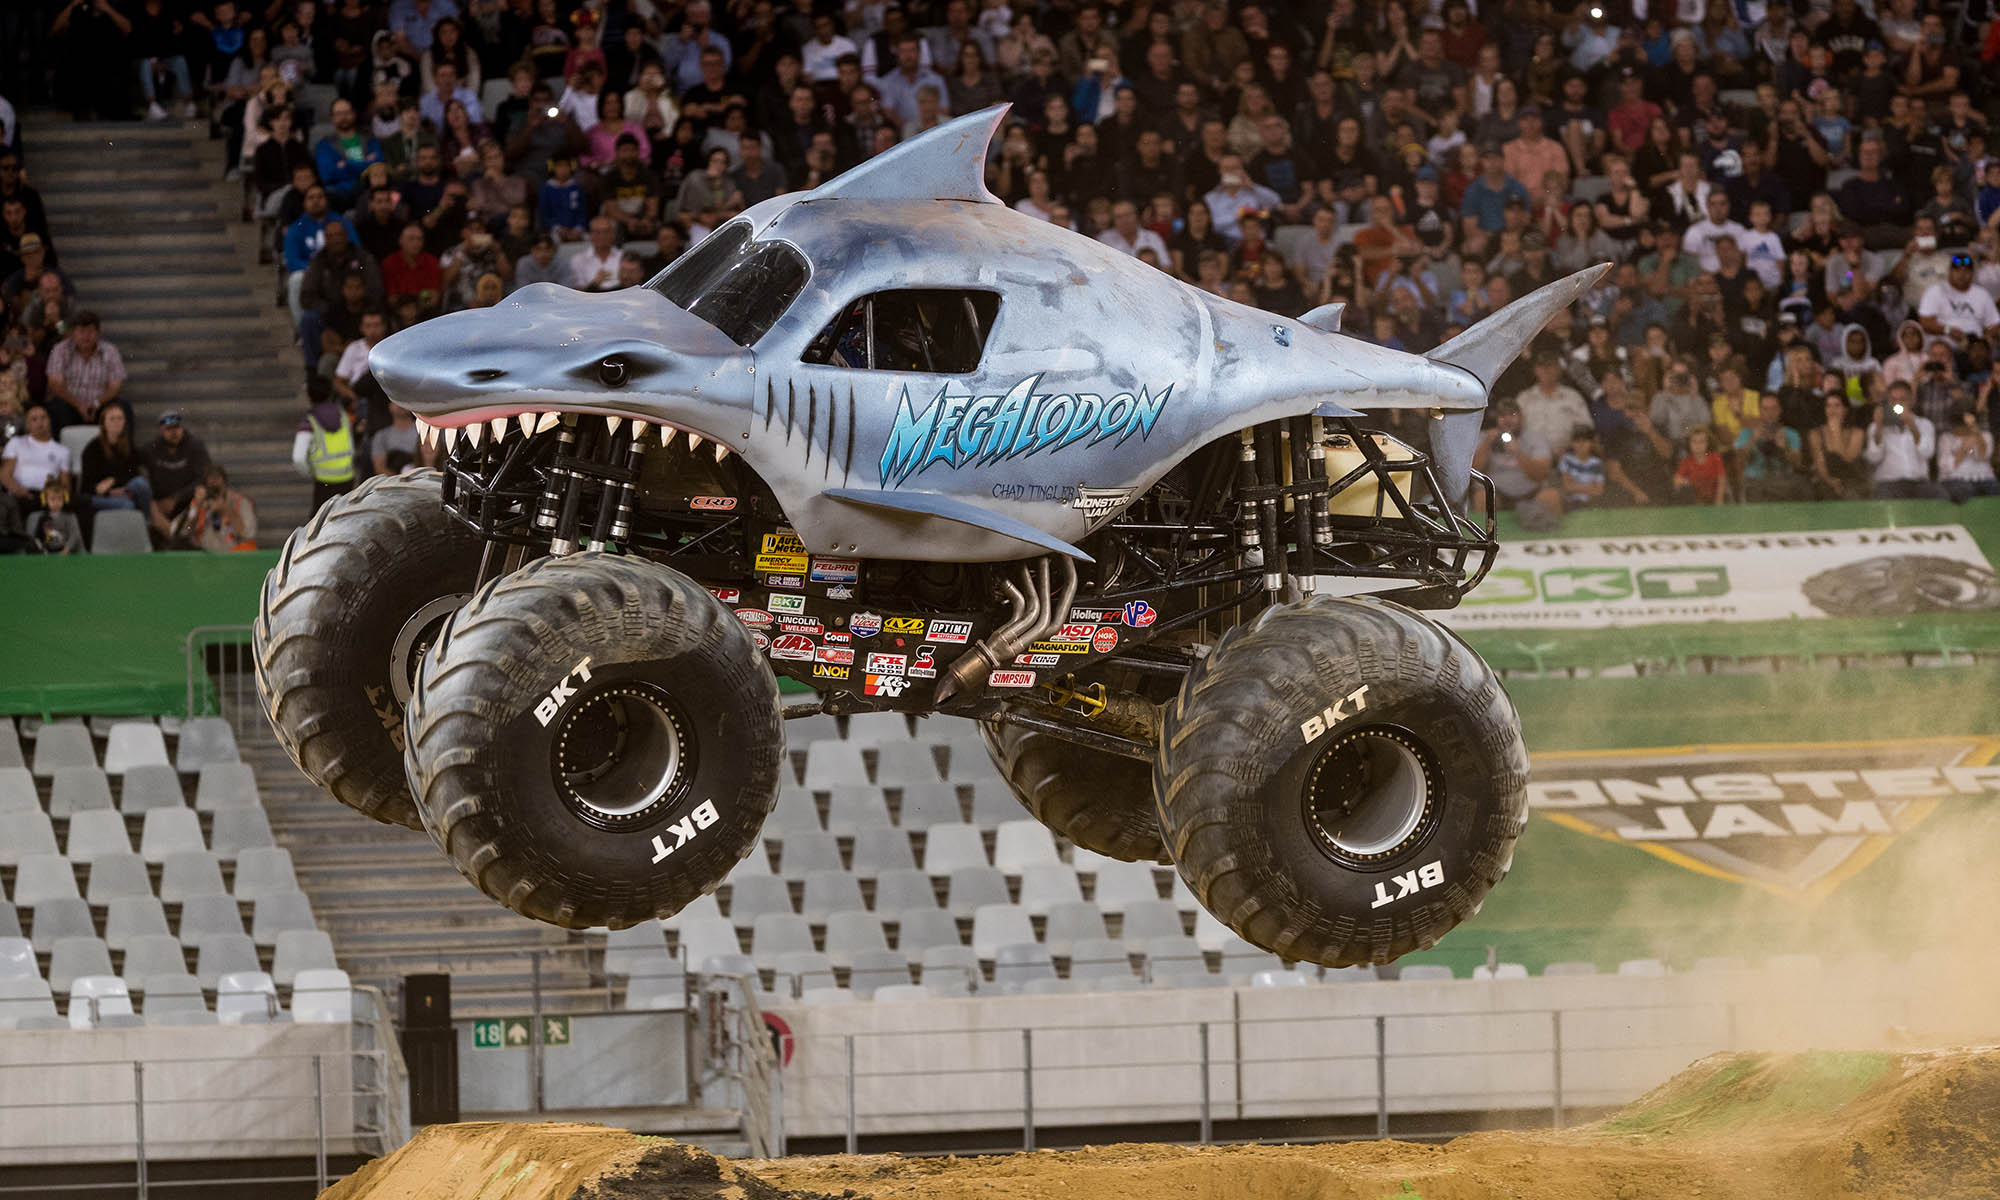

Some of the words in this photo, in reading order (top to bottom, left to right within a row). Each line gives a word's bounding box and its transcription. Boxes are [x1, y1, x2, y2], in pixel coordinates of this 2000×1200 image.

[878, 371, 1175, 490] MEGALODON
[992, 483, 1025, 501] CHAD
[1028, 484, 1075, 501] TINGLER
[694, 498, 735, 506] CRD
[1072, 496, 1131, 509] MONSTER
[1086, 507, 1112, 518] JAM
[1600, 536, 1834, 555] MONSTER
[1857, 531, 1957, 545] JAM
[771, 595, 802, 609] BKT
[778, 615, 816, 626] LINCOLN
[1072, 609, 1102, 622] Holley
[1125, 600, 1148, 627] VP
[785, 624, 819, 633] WELDERS
[932, 623, 967, 634] OPTIMA
[1056, 625, 1095, 637] MSD
[825, 632, 849, 643] Coan
[1098, 632, 1115, 640] NGK
[773, 635, 814, 652] JAZ
[1031, 643, 1088, 652] MAGNAFLOW
[813, 664, 850, 679] UNOH
[992, 673, 1032, 685] SIMPSON
[533, 656, 592, 728] BKT
[1301, 684, 1369, 744] BKT
[1527, 766, 2000, 809] ONSTER
[1617, 800, 1892, 840] JAM
[651, 799, 720, 865] BKT
[1370, 860, 1446, 910] BKT
[475, 1023, 501, 1044] 18
